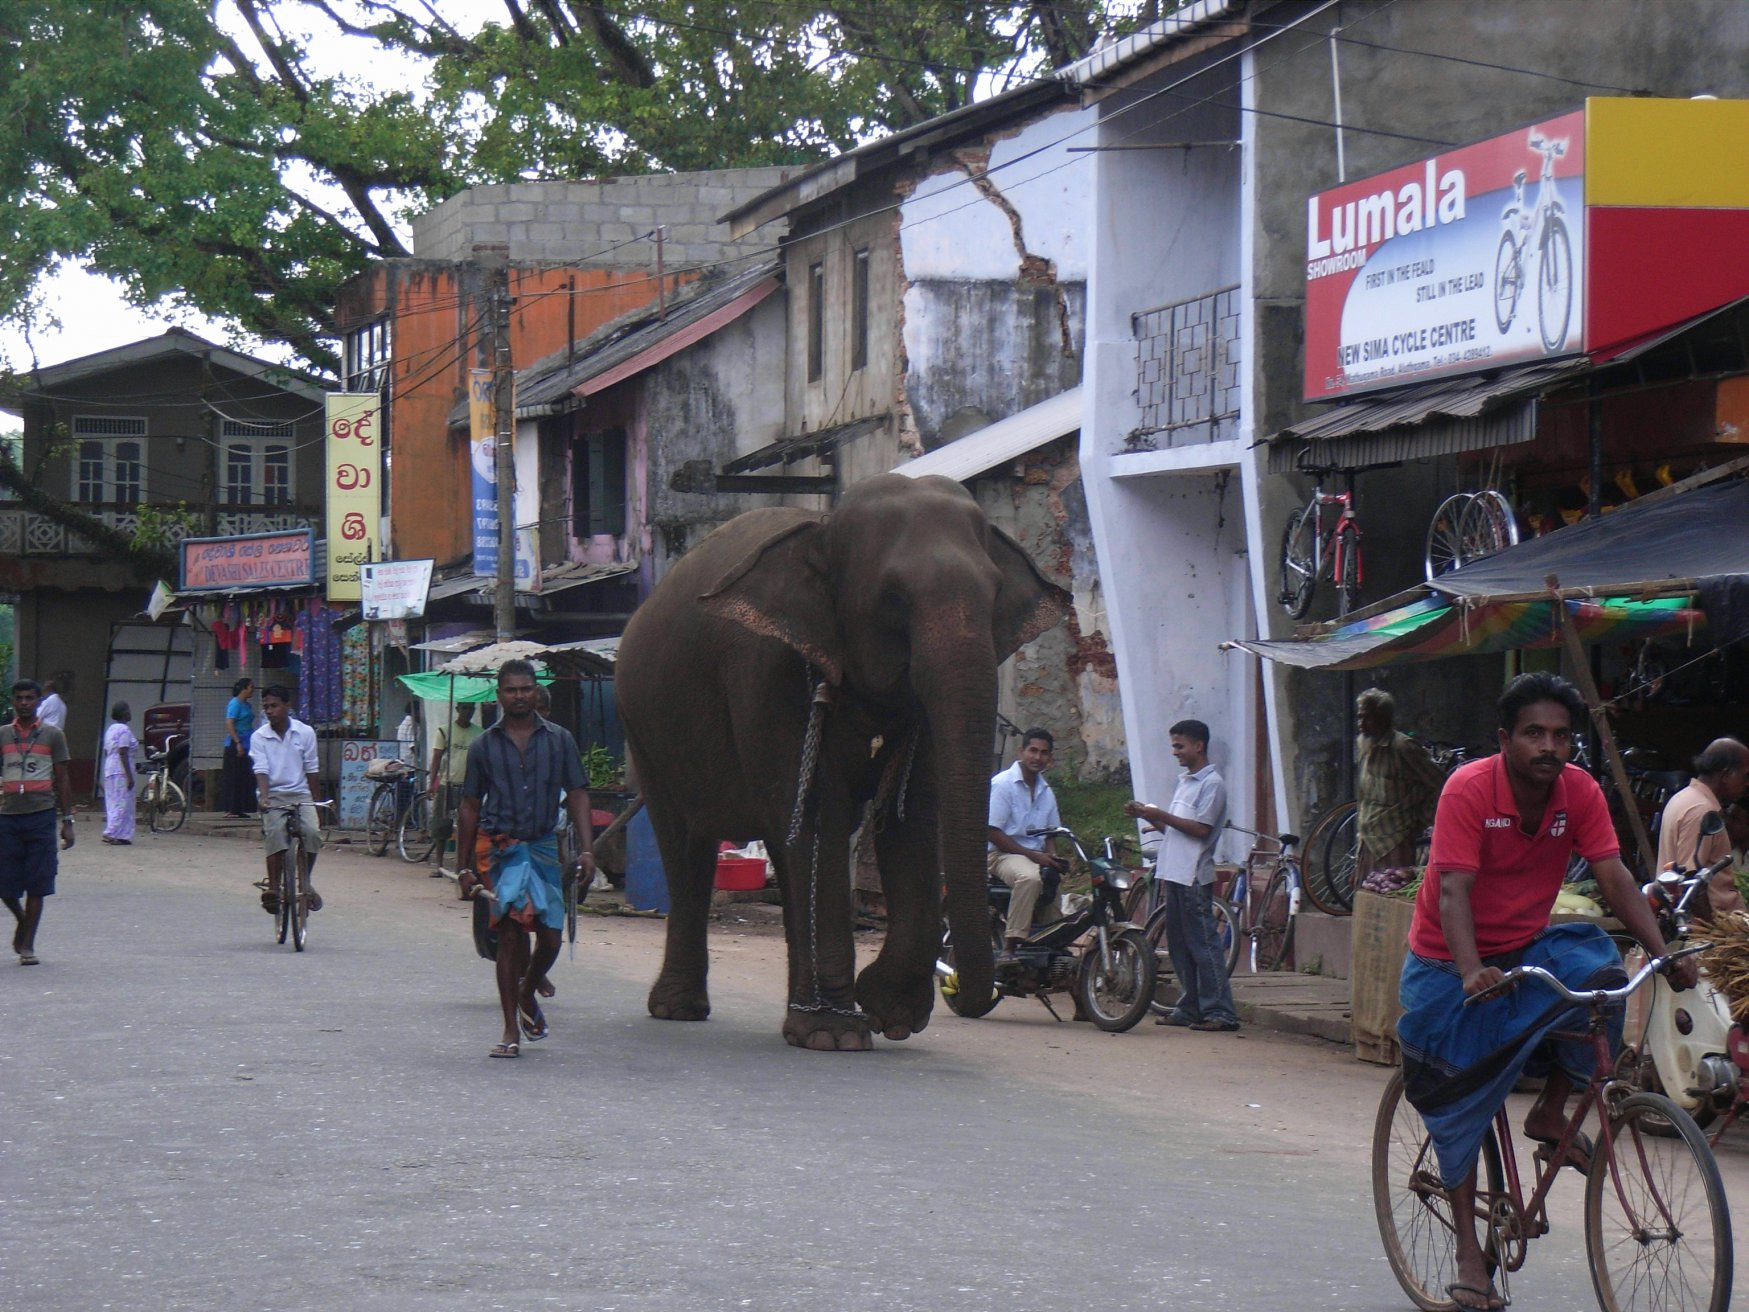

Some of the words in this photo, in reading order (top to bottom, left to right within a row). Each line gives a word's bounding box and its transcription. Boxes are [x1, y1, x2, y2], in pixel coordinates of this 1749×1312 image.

[1308, 159, 1466, 261] Lumala
[1307, 249, 1367, 281] SHOWROOM
[1366, 270, 1386, 290] FIRST
[1386, 269, 1396, 286] IN
[1396, 264, 1411, 283] THE
[1411, 258, 1435, 279] FEALD
[1416, 283, 1437, 303] STILL
[1438, 280, 1447, 299] IN
[1447, 276, 1463, 296] THE
[1464, 271, 1484, 292] LEAD
[1338, 342, 1361, 369] NEW
[1363, 337, 1389, 362] SIMA
[1392, 328, 1427, 356] CYCLE
[1430, 318, 1476, 348] CENTRE
